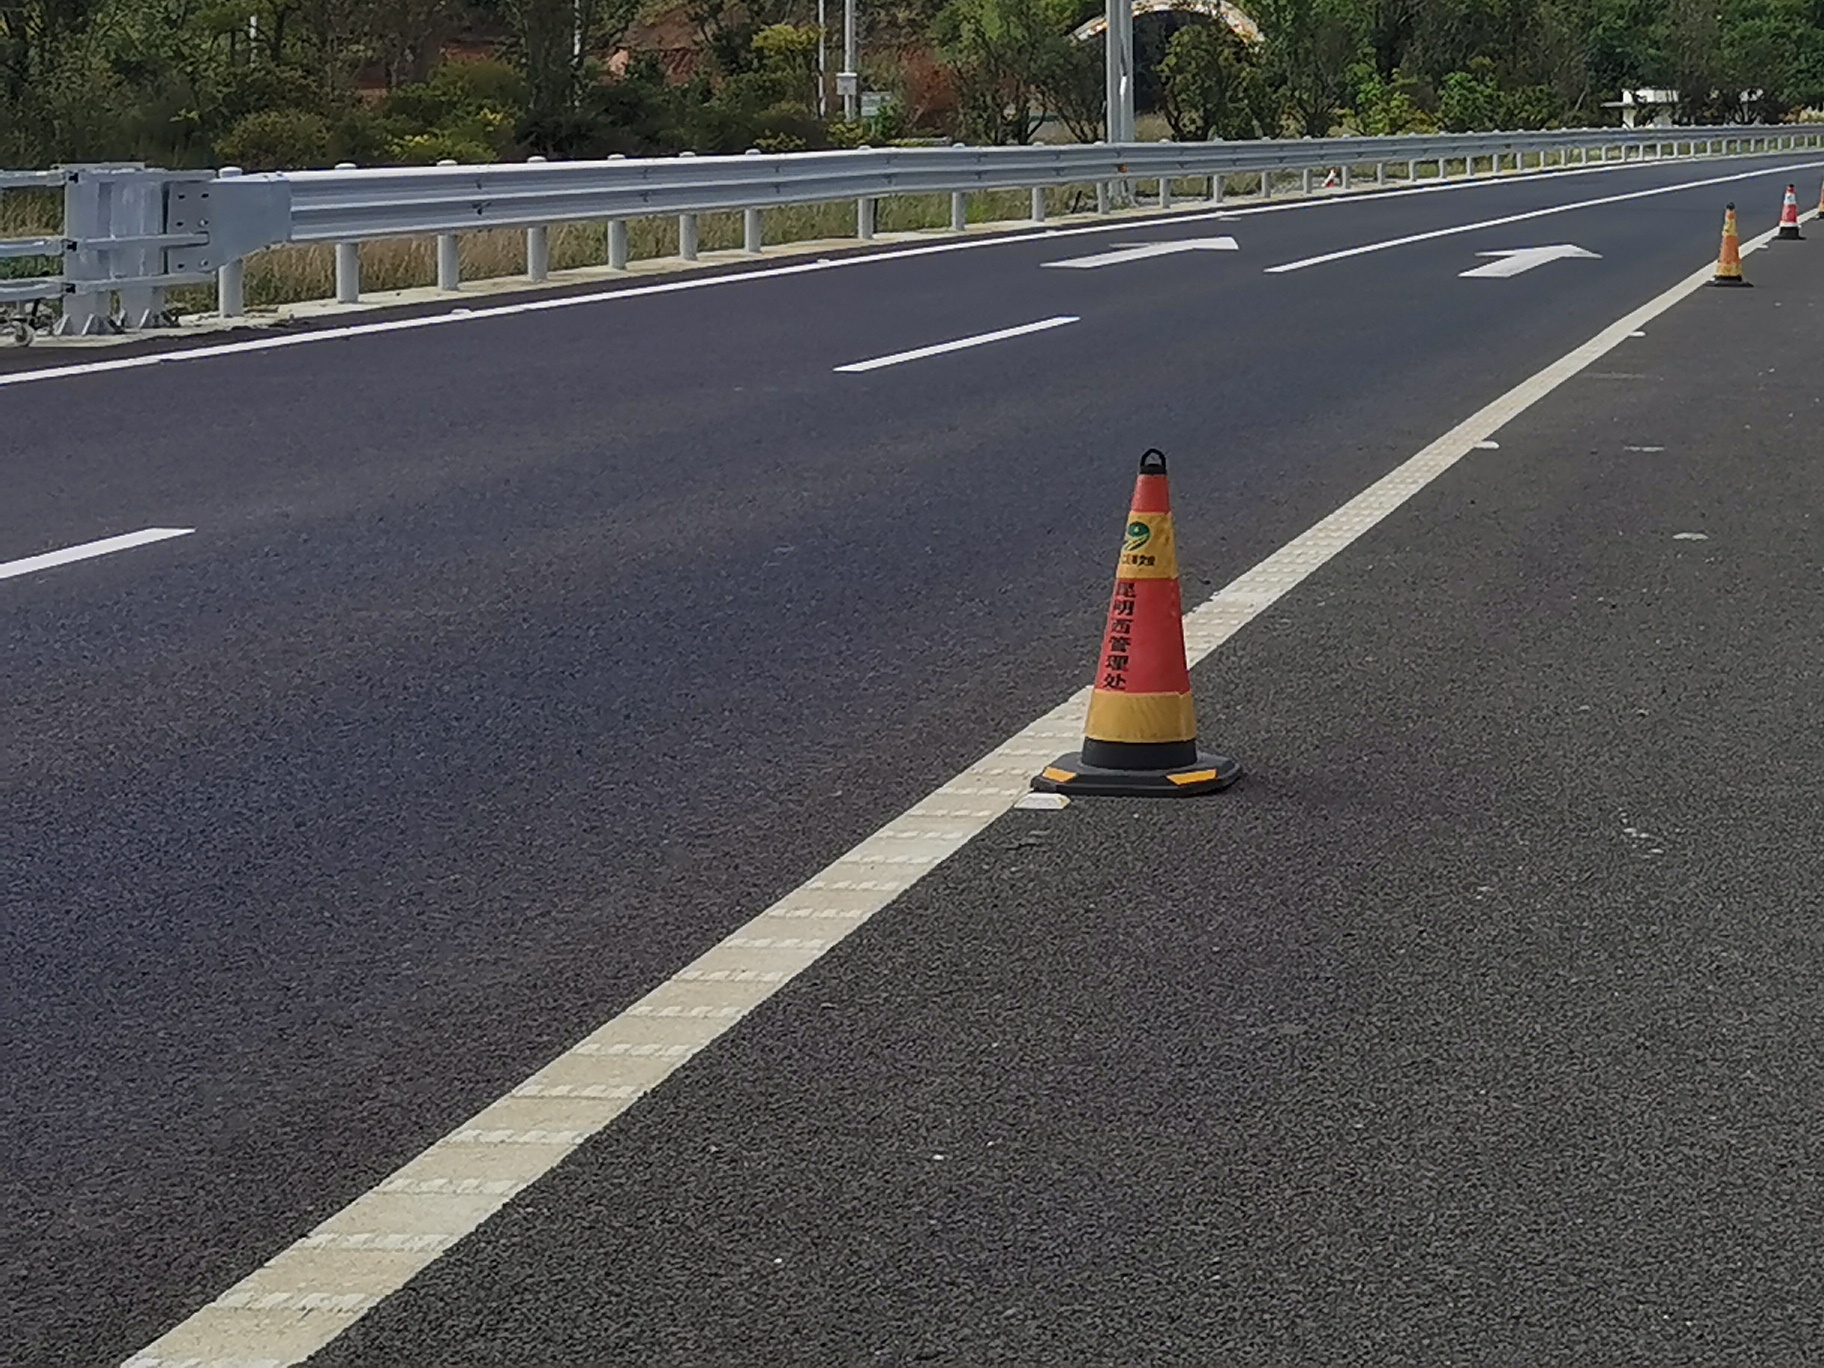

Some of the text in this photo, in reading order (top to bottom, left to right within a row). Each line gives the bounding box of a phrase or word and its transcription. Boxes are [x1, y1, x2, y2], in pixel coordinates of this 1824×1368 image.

[1103, 582, 1136, 690] 昆明西管理处
